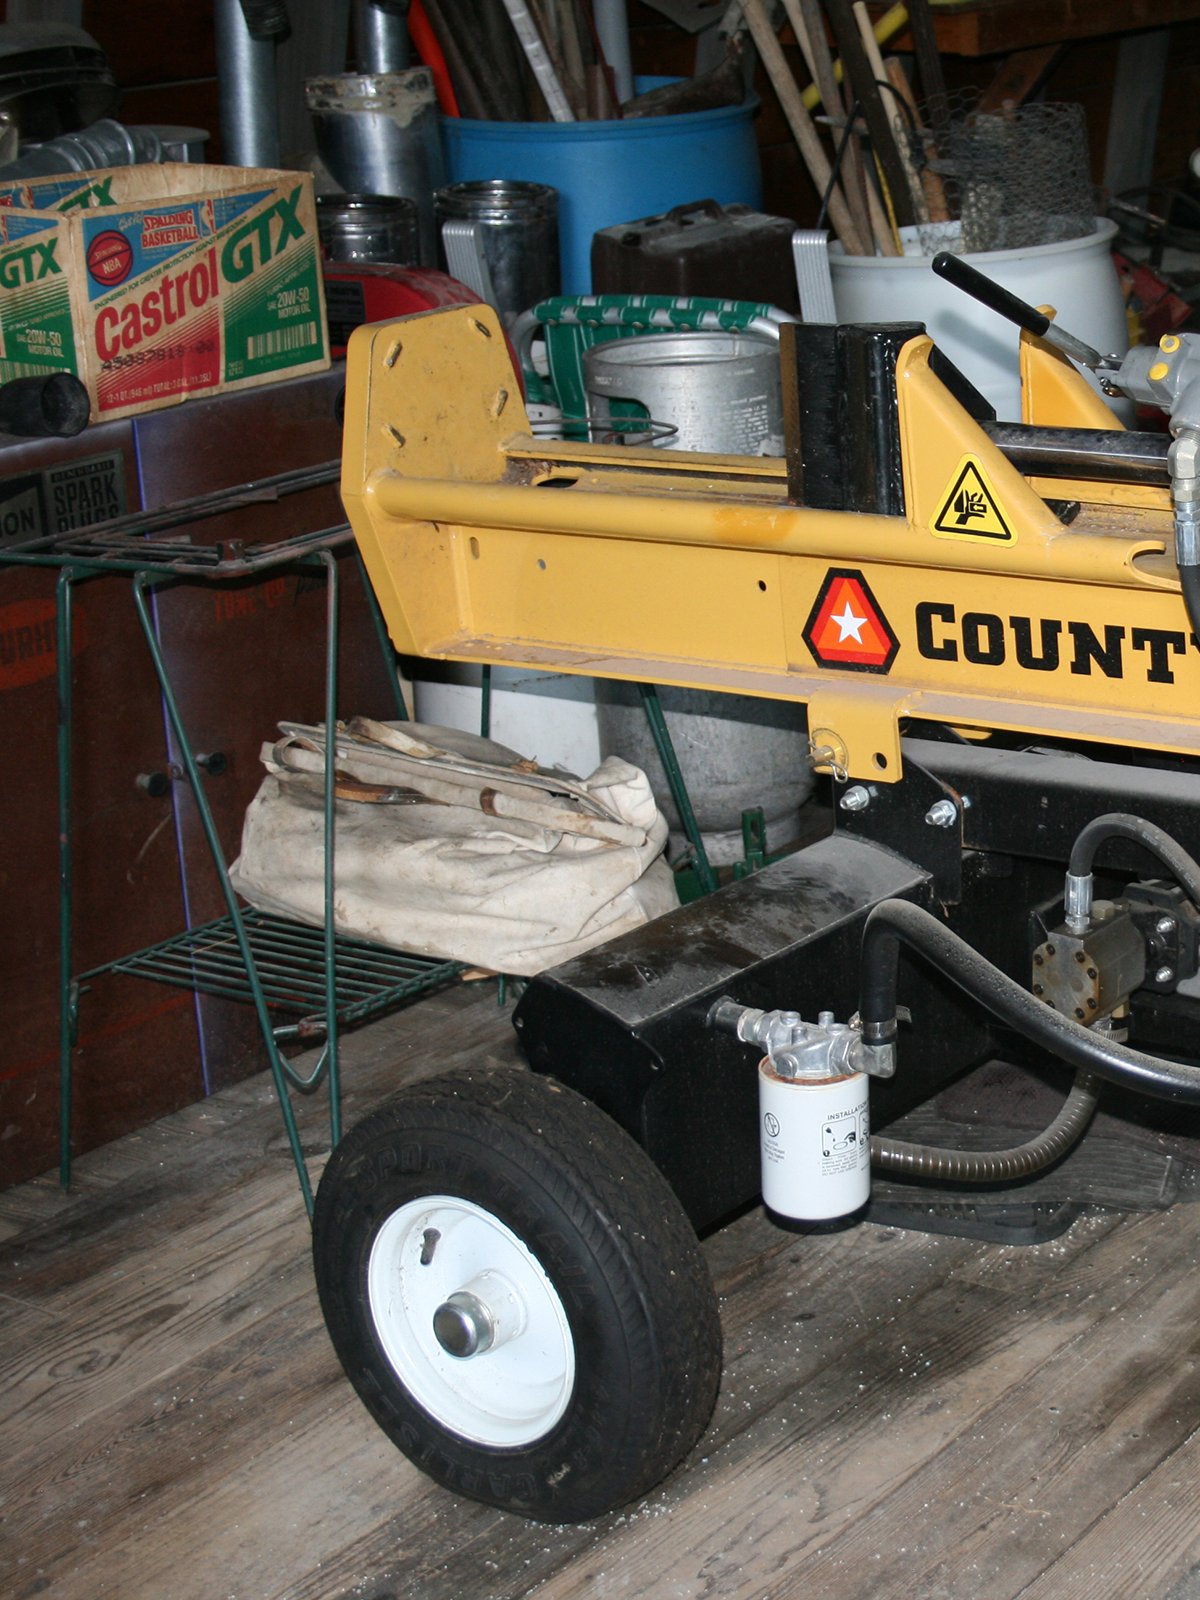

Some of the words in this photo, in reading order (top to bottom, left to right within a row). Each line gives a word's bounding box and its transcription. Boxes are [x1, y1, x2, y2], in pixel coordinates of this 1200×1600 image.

[56, 175, 118, 212] TX
[143, 209, 194, 231] SPALDING
[221, 183, 306, 284] GTX
[141, 226, 199, 250] BASKETBALL
[0, 237, 62, 289] GTX
[102, 257, 122, 274] NBA
[95, 246, 219, 362] Castrol
[277, 286, 310, 308] 20W-50
[25, 328, 63, 347] 20W-50
[54, 471, 119, 516] SPARK
